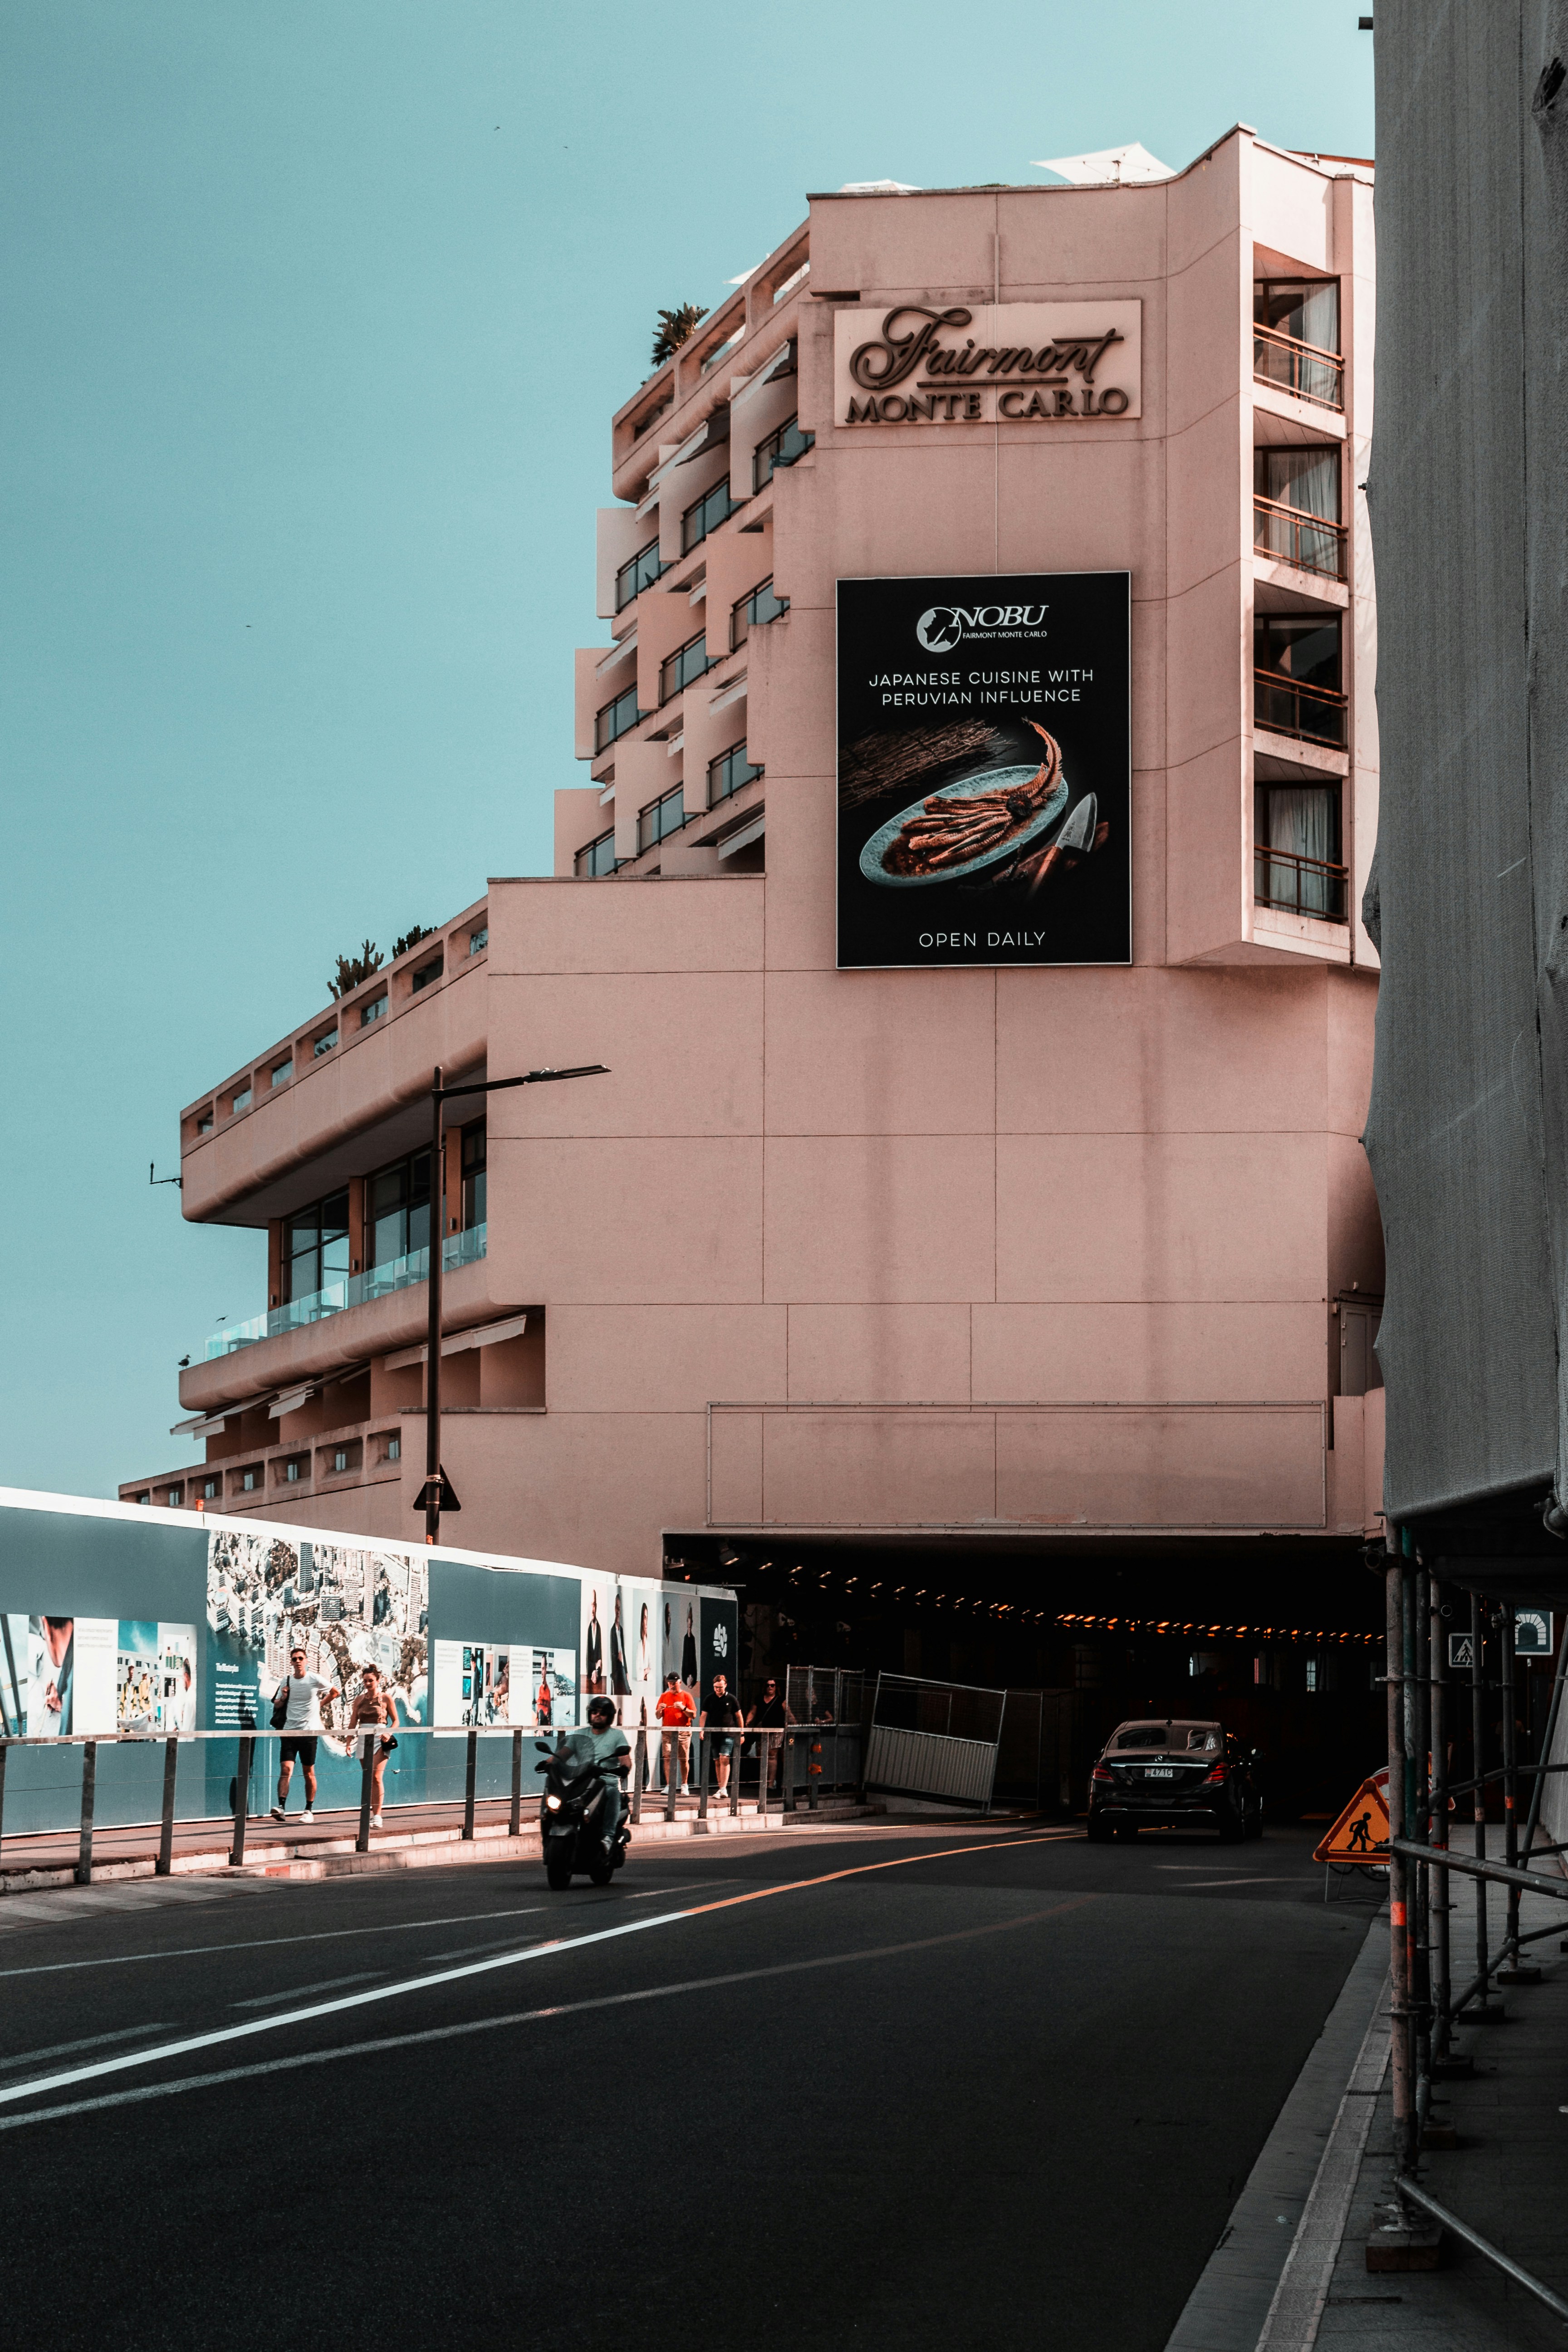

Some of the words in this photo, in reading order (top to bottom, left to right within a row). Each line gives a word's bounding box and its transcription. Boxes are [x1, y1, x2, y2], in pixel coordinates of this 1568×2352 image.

[849, 306, 1124, 391] Fairmont
[845, 392, 982, 422] MONTE
[998, 387, 1129, 418] CARLO
[949, 605, 1049, 627] NOBU
[869, 672, 961, 686] JAPANESE
[969, 671, 1041, 684] CUISINE
[1048, 669, 1093, 682] WITH
[882, 691, 971, 706] PERUVIAN
[980, 689, 1081, 703] INFLUENCE
[919, 932, 976, 947] OPEN
[988, 931, 1045, 946] DAILY
